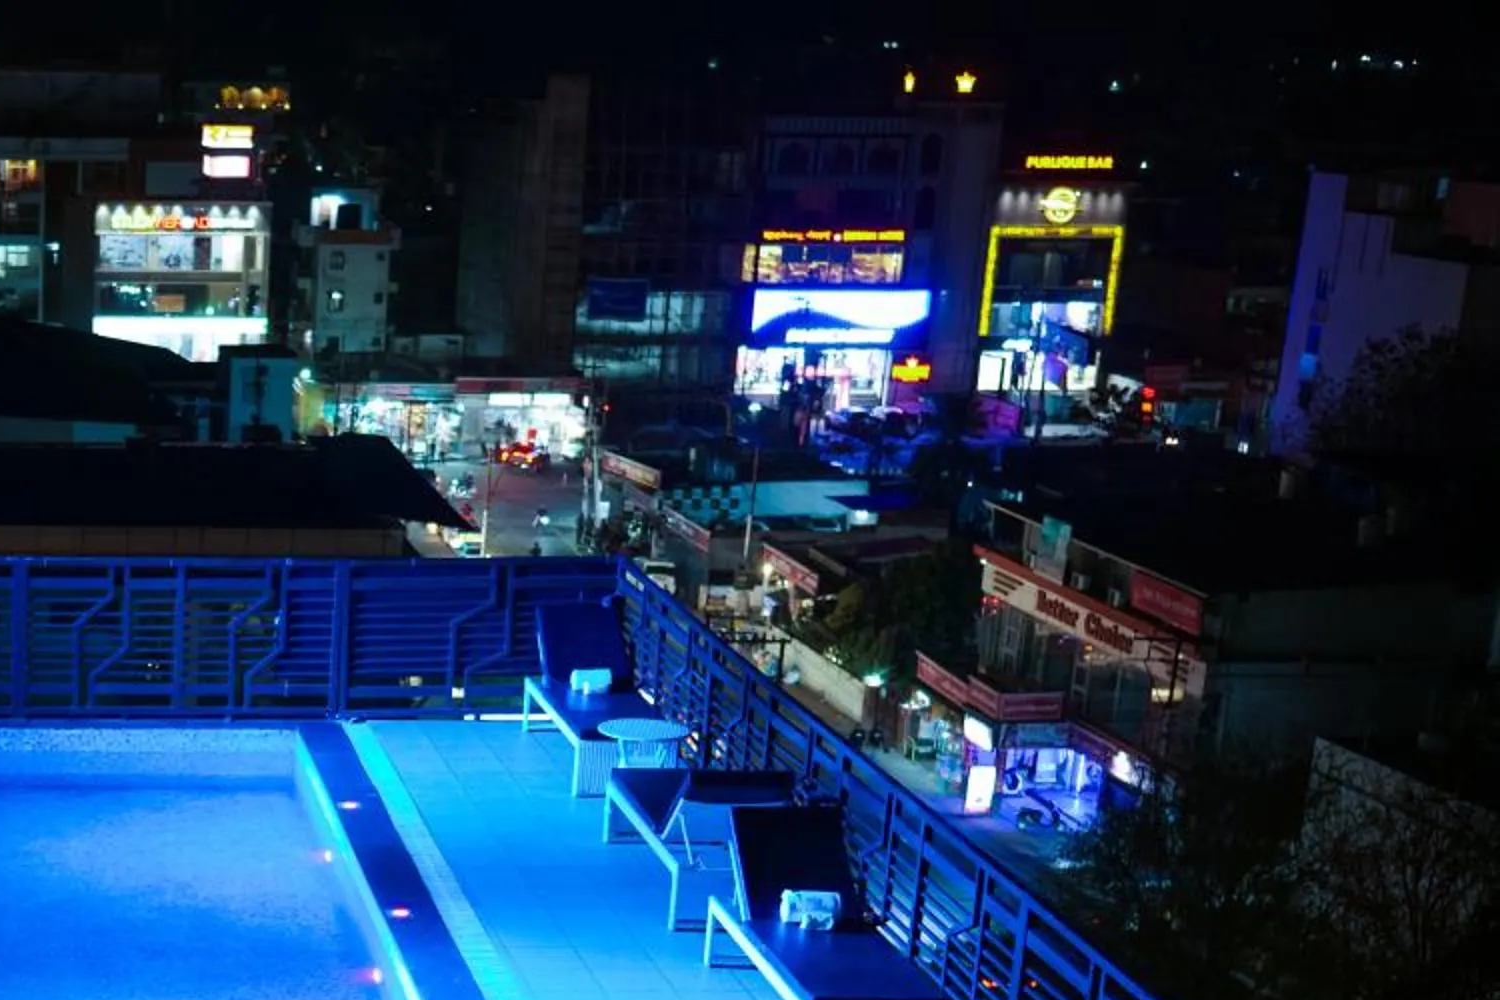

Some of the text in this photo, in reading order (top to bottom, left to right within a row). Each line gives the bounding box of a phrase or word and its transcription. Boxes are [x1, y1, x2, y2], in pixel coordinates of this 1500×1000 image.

[1088, 155, 1113, 169] BAR
[1036, 589, 1134, 654] Better Choice
